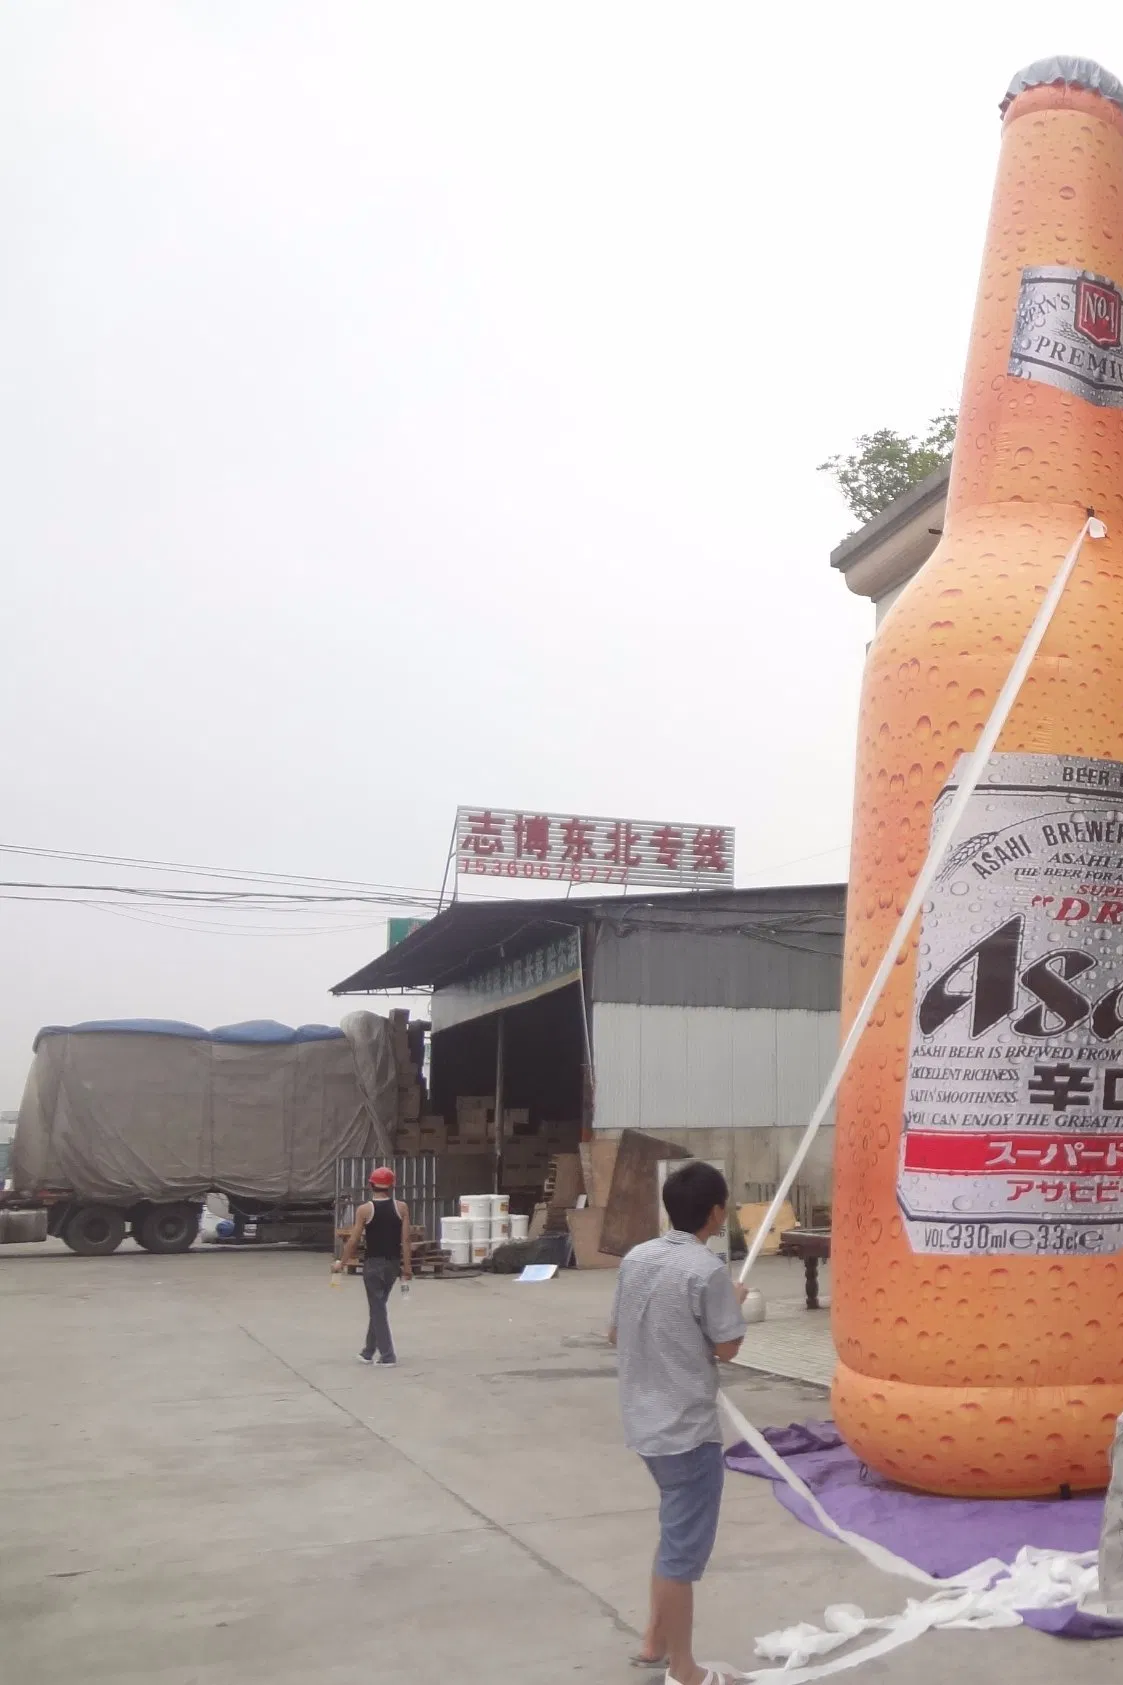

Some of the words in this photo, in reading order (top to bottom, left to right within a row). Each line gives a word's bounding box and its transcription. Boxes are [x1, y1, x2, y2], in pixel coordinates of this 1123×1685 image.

[1062, 766, 1110, 786] BEER
[972, 834, 1032, 880] ASAHI
[1047, 852, 1111, 868] ASAHI
[1014, 867, 1040, 877] THE
[1044, 867, 1083, 879] BEER
[1085, 870, 1113, 881] FOR
[912, 1045, 947, 1057] ASAHI
[948, 1046, 984, 1059] BEER
[988, 1046, 1003, 1059] IS
[1005, 1046, 1075, 1060] BREWED
[1076, 1047, 1121, 1061] FROM
[962, 1068, 1019, 1081] RICHNESS
[936, 1090, 1018, 1104] SMOOTHNESS
[931, 1112, 960, 1125] CAN
[961, 1113, 1013, 1127] ENJOY
[1015, 1113, 1051, 1127] THE
[1055, 1115, 1112, 1128] GREAT
